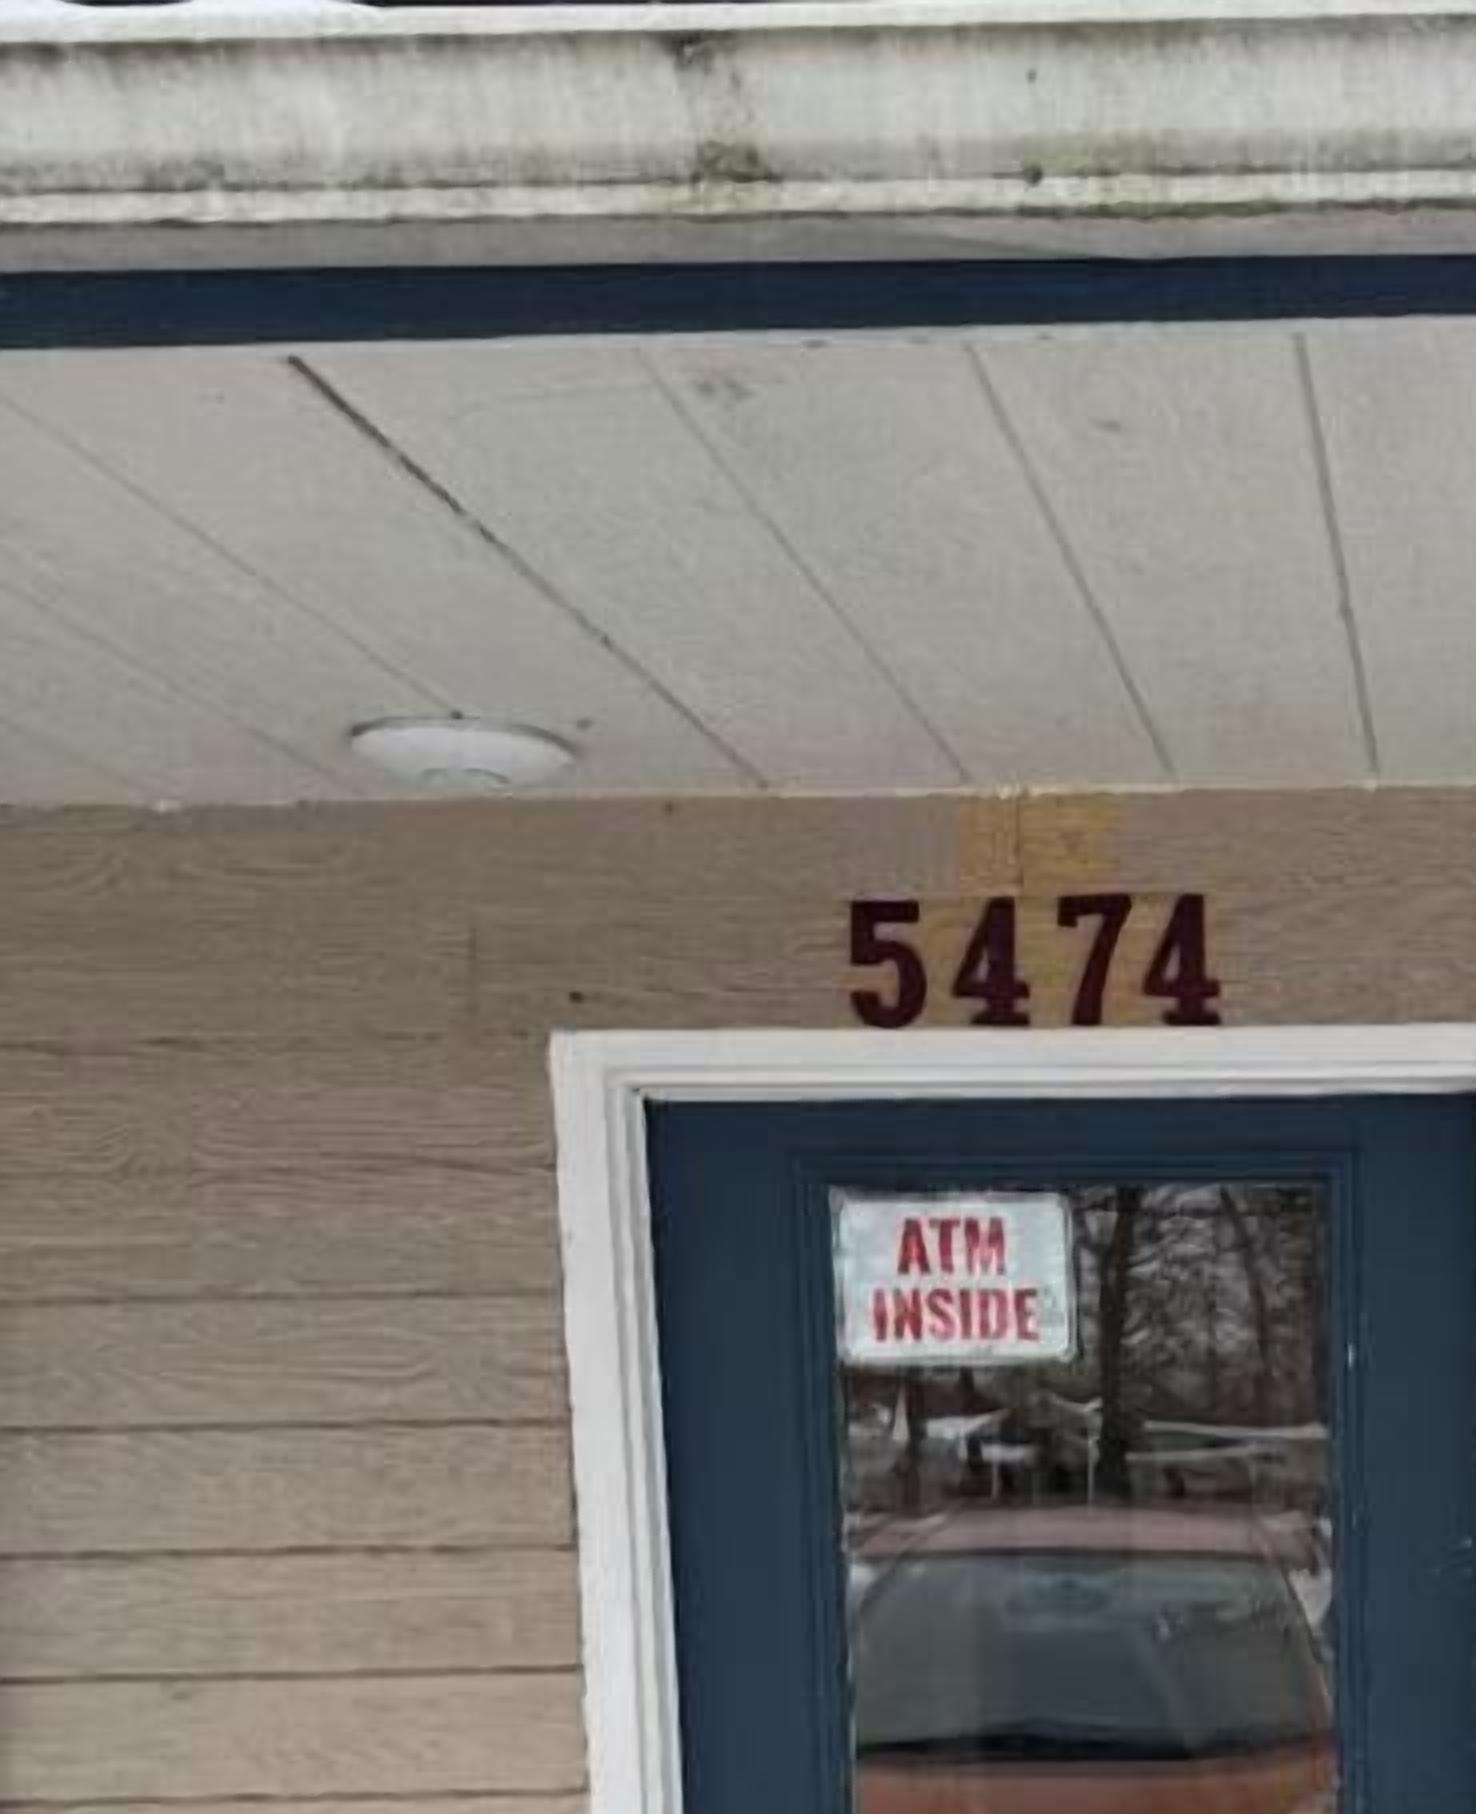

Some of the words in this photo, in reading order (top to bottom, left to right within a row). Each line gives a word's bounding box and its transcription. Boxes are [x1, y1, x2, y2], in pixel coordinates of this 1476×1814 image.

[849, 893, 1222, 1029] 5474
[896, 1216, 1006, 1276] ATM
[870, 1287, 1041, 1343] INSIDE
